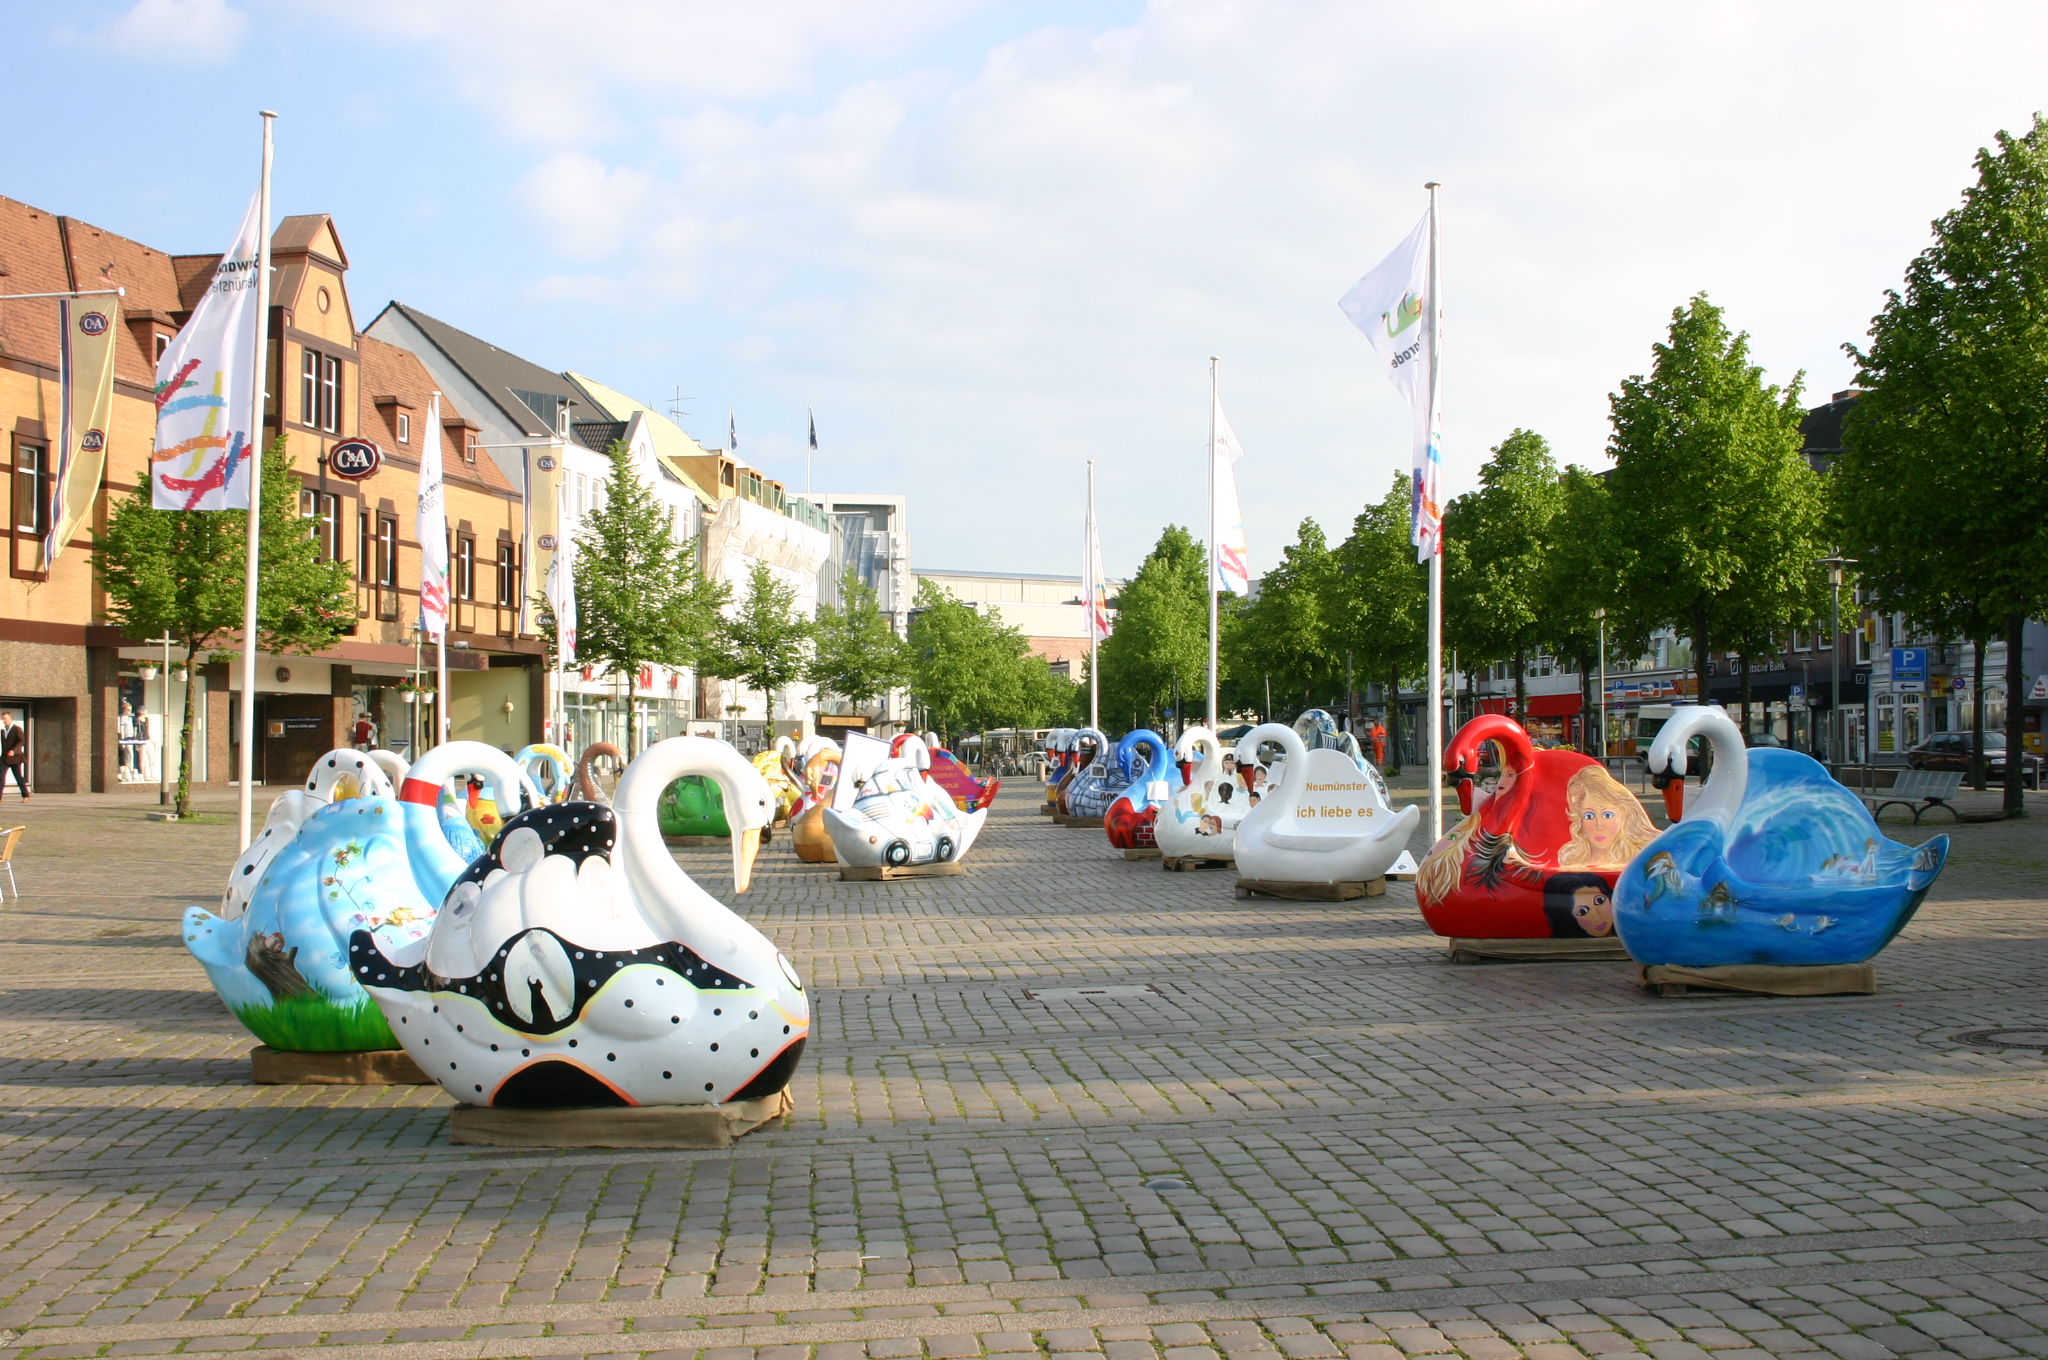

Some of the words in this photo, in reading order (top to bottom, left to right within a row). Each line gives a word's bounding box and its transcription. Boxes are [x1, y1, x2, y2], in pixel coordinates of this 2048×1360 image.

[84, 318, 103, 330] C&A
[83, 435, 102, 447] C&A
[337, 449, 370, 469] C&A
[895, 533, 907, 643] KARSTADT
[1903, 651, 1915, 666] P
[1769, 661, 1786, 671] Bank
[1616, 681, 1622, 689] P
[1793, 687, 1801, 695] P
[1306, 782, 1367, 792] Neumünster
[1296, 806, 1316, 818] ich
[1320, 806, 1353, 818] liebe
[1357, 808, 1374, 818] es
